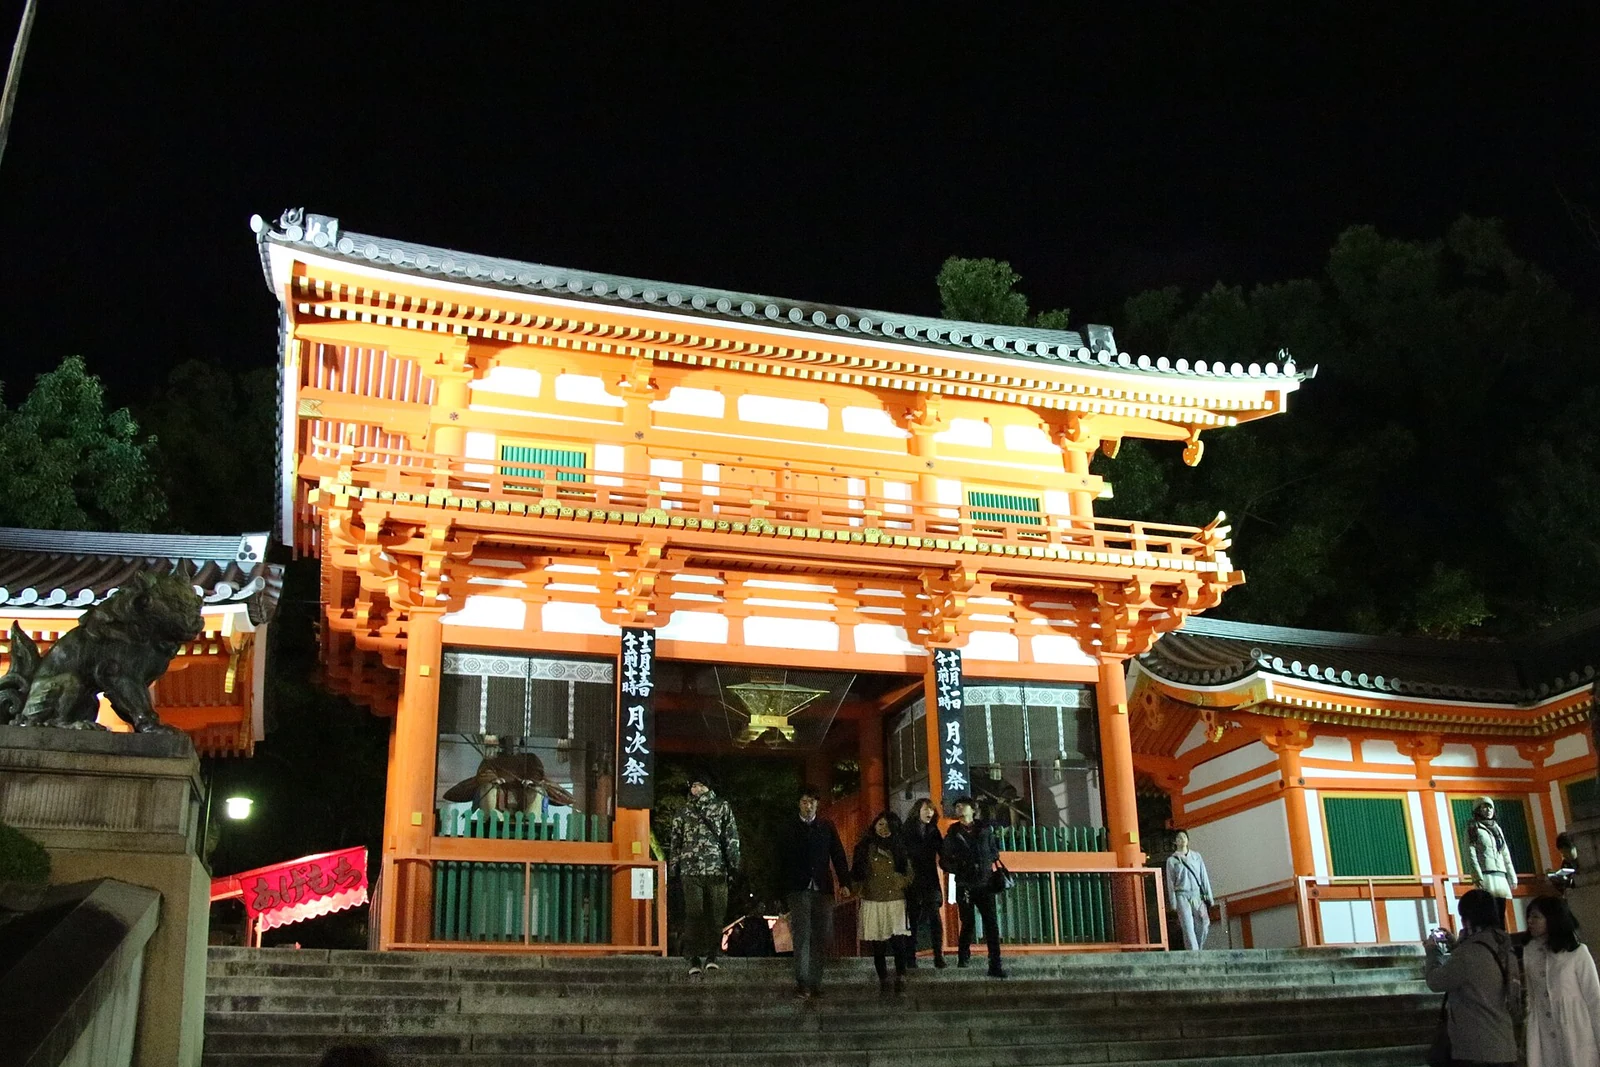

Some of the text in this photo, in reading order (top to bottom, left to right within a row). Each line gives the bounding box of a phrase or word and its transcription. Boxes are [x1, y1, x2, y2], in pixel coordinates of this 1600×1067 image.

[622, 631, 639, 696] 午前十時
[935, 650, 951, 710] 午前十時
[622, 704, 650, 785] 月次祭
[944, 720, 968, 791] 月次祭
[252, 856, 362, 911] あげもち
